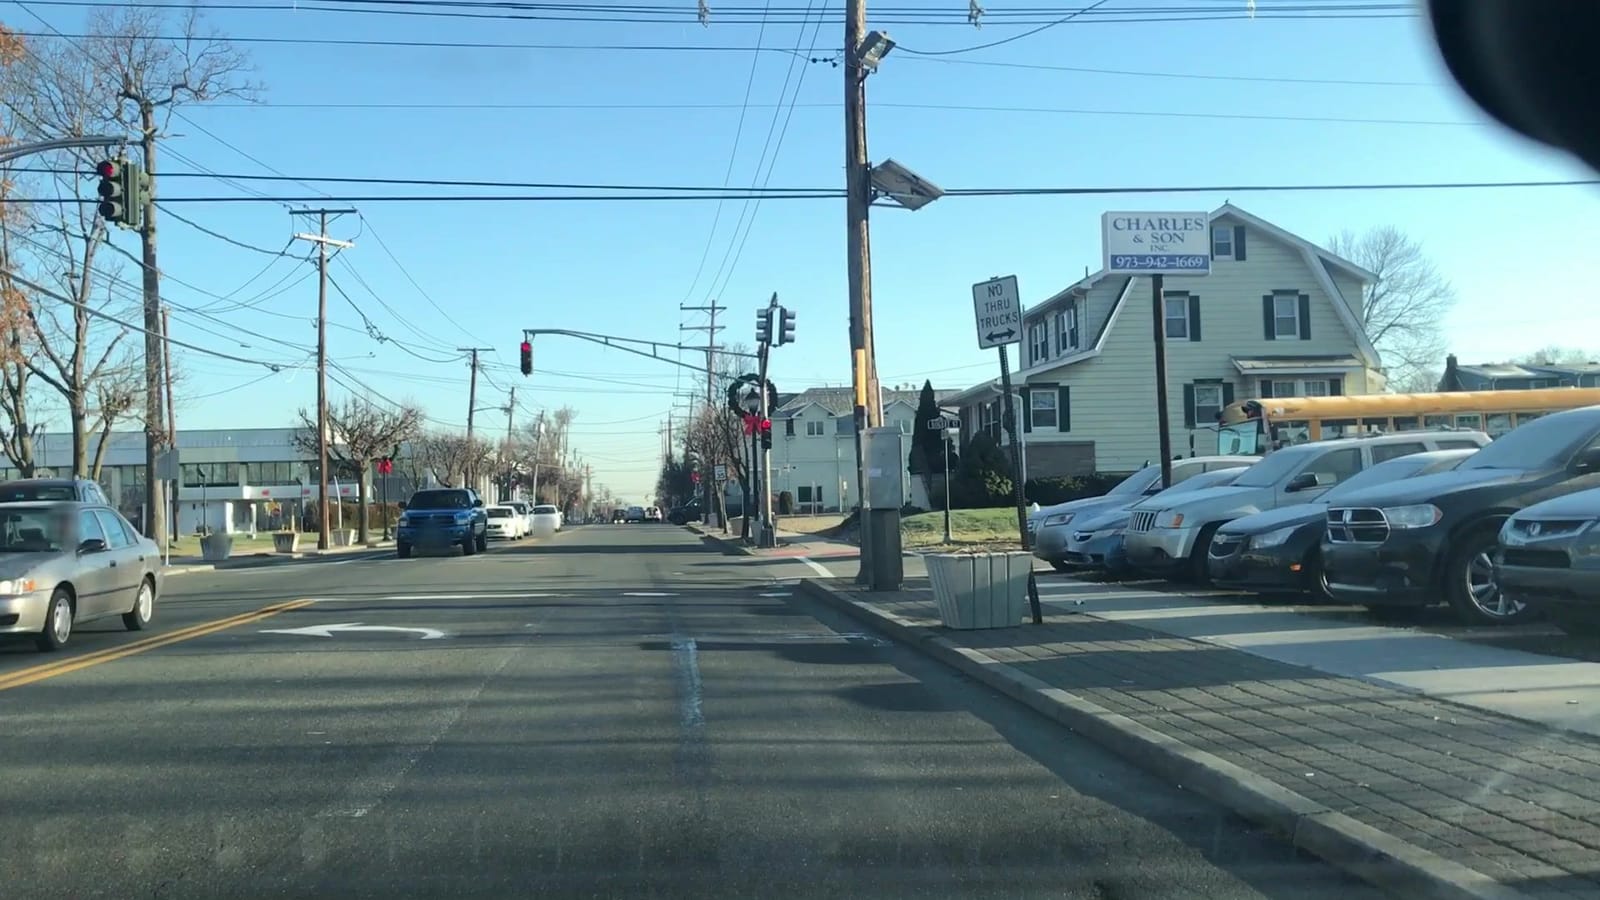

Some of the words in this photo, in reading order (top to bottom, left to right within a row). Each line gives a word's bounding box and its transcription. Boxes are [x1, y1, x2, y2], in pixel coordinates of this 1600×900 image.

[1113, 218, 1204, 231] CHARLES
[1132, 234, 1144, 244] &
[1150, 232, 1185, 244] SON
[1116, 256, 1203, 268] 973-942-1669
[988, 284, 1003, 298] NO
[984, 298, 1010, 313] THRU
[980, 312, 1018, 328] TRUCKS
